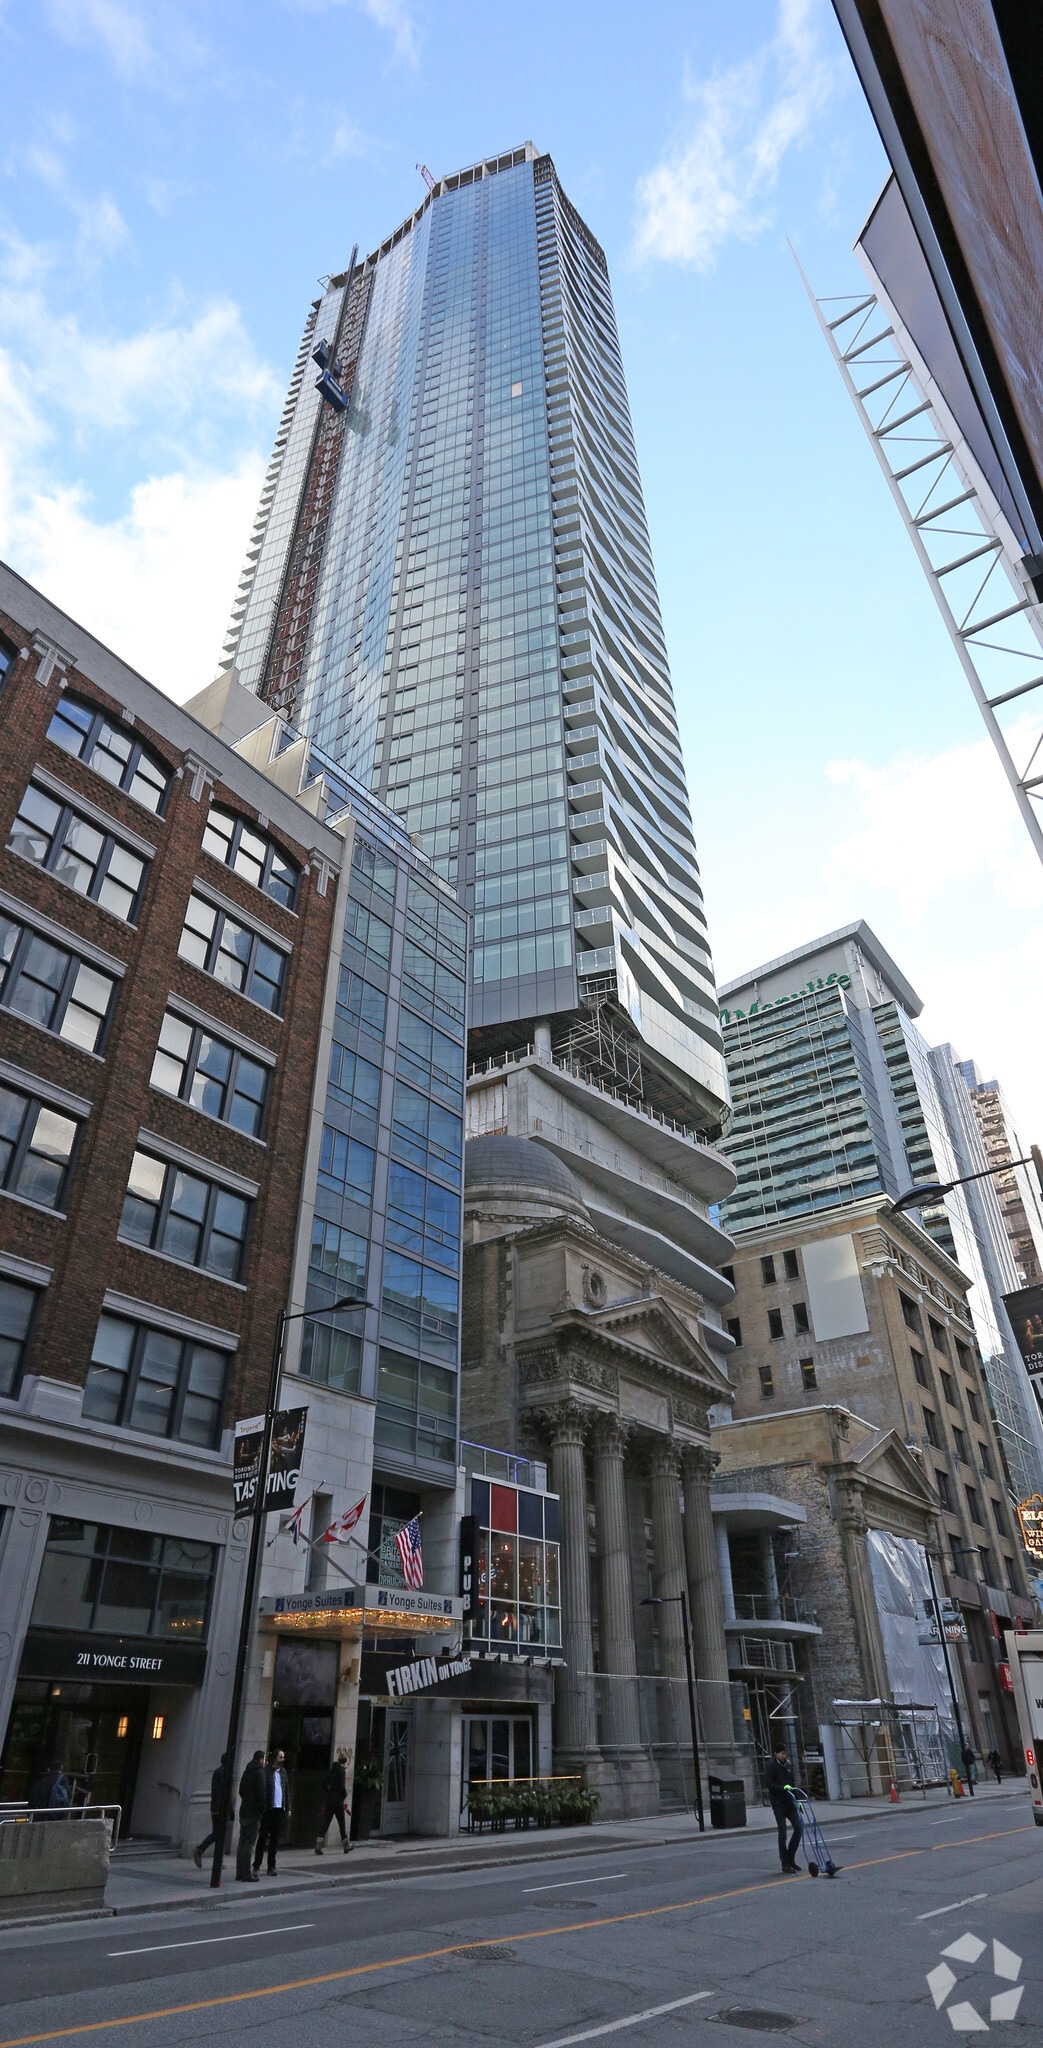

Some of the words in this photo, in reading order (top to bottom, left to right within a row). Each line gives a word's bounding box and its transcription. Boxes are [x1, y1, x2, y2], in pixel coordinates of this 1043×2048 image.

[733, 972, 851, 1020] Mlife
[233, 1468, 300, 1503] TASTING
[463, 1555, 472, 1611] PUB
[286, 1597, 312, 1612] Yonge
[315, 1595, 342, 1608] Suites
[389, 1593, 415, 1611] Yonge
[417, 1597, 442, 1612] Suites
[76, 1653, 90, 1665] 211
[93, 1654, 127, 1668] YONGE
[129, 1656, 163, 1670] STREET
[385, 1656, 438, 1697] FIRKIN
[438, 1664, 450, 1681] ON
[449, 1657, 472, 1678] YONGE
